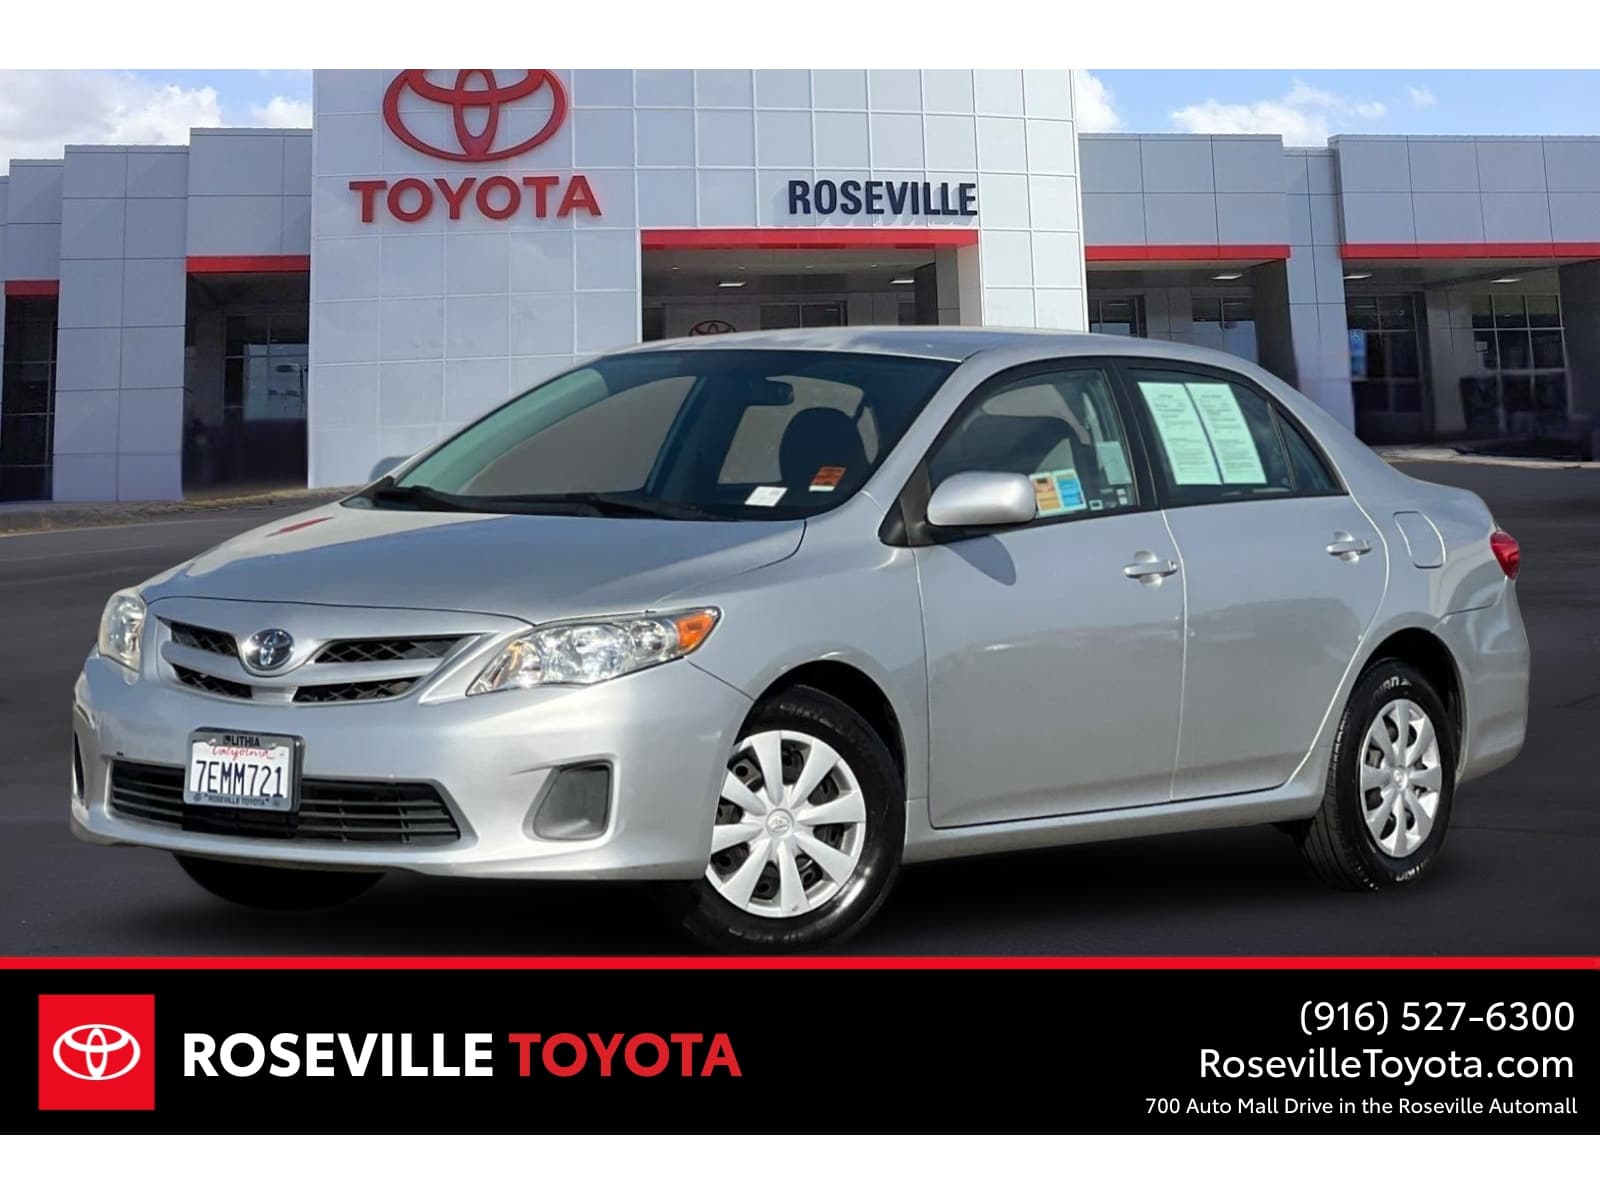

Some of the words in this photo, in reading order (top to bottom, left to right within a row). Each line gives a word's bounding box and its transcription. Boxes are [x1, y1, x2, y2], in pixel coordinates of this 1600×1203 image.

[349, 175, 602, 223] TOYOTA
[788, 179, 979, 217] ROSEVILLE
[231, 735, 261, 747] LITHIA
[195, 760, 284, 799] 7EMM721
